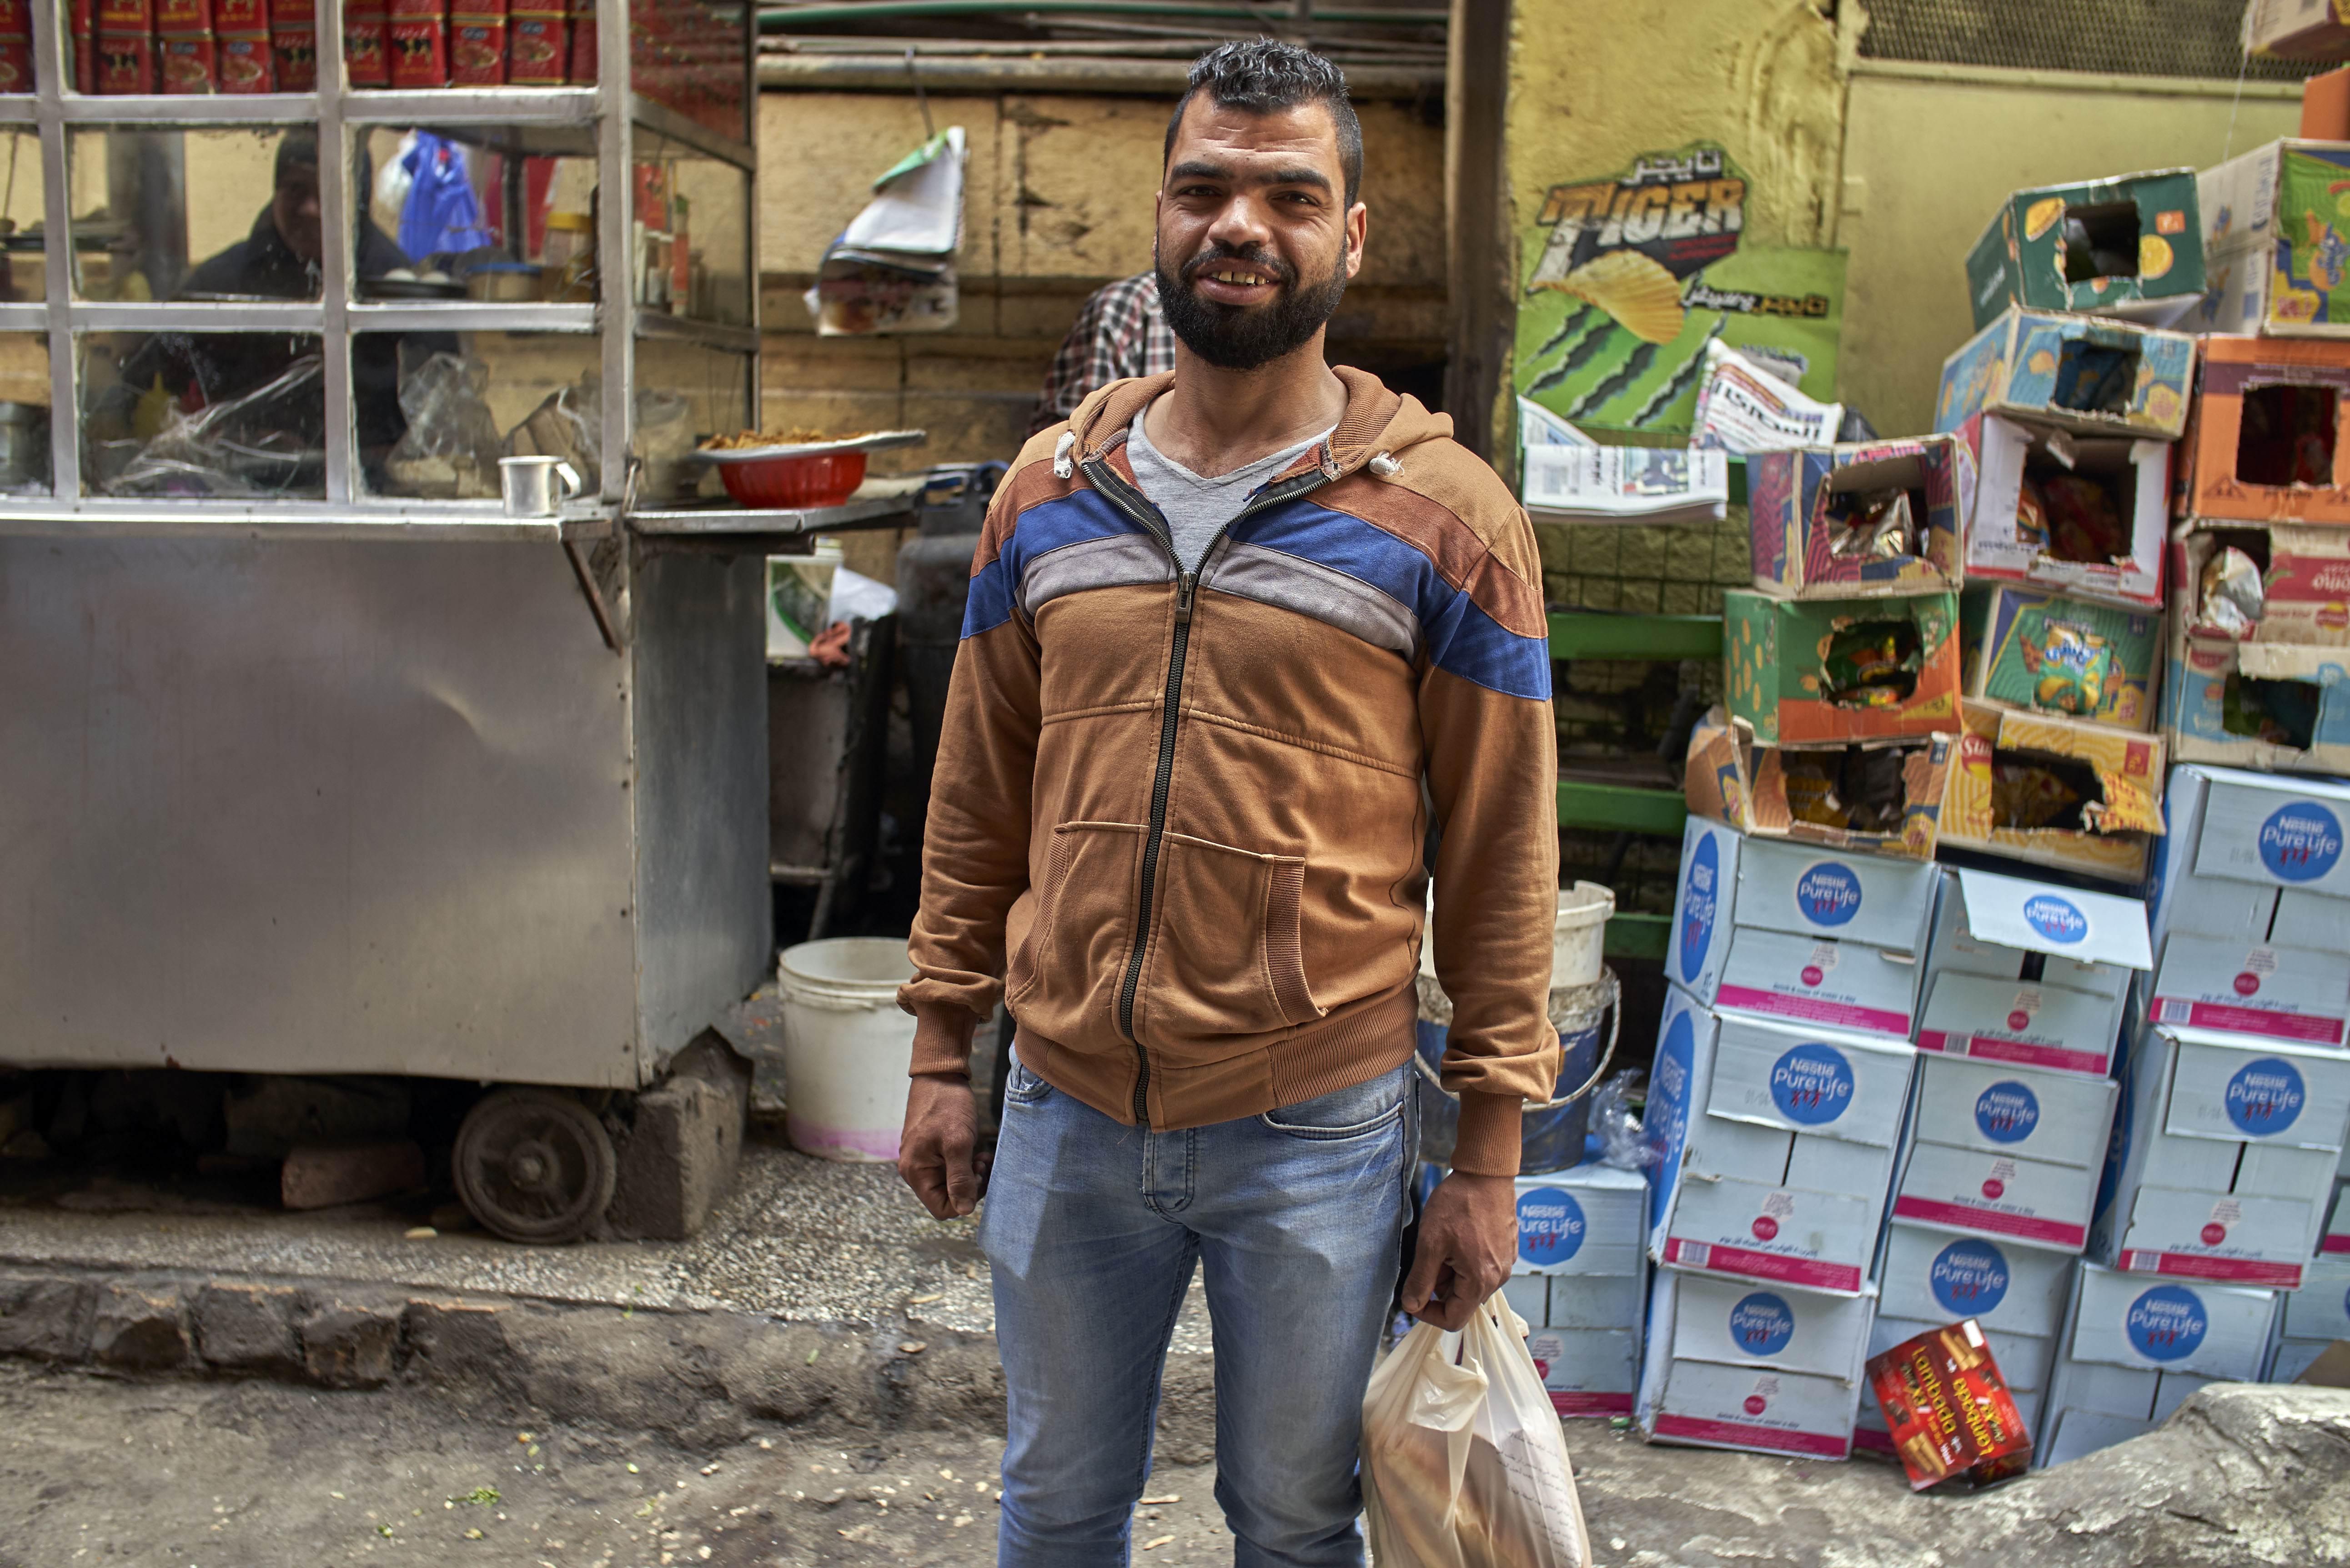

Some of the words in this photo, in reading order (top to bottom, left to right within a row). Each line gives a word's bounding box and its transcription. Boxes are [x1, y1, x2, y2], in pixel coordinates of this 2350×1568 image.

[1622, 151, 1722, 185] تايجر
[1526, 179, 1745, 294] TIGER
[1912, 1345, 1956, 1434] Lambada
[1953, 1377, 1994, 1456] Lambada
